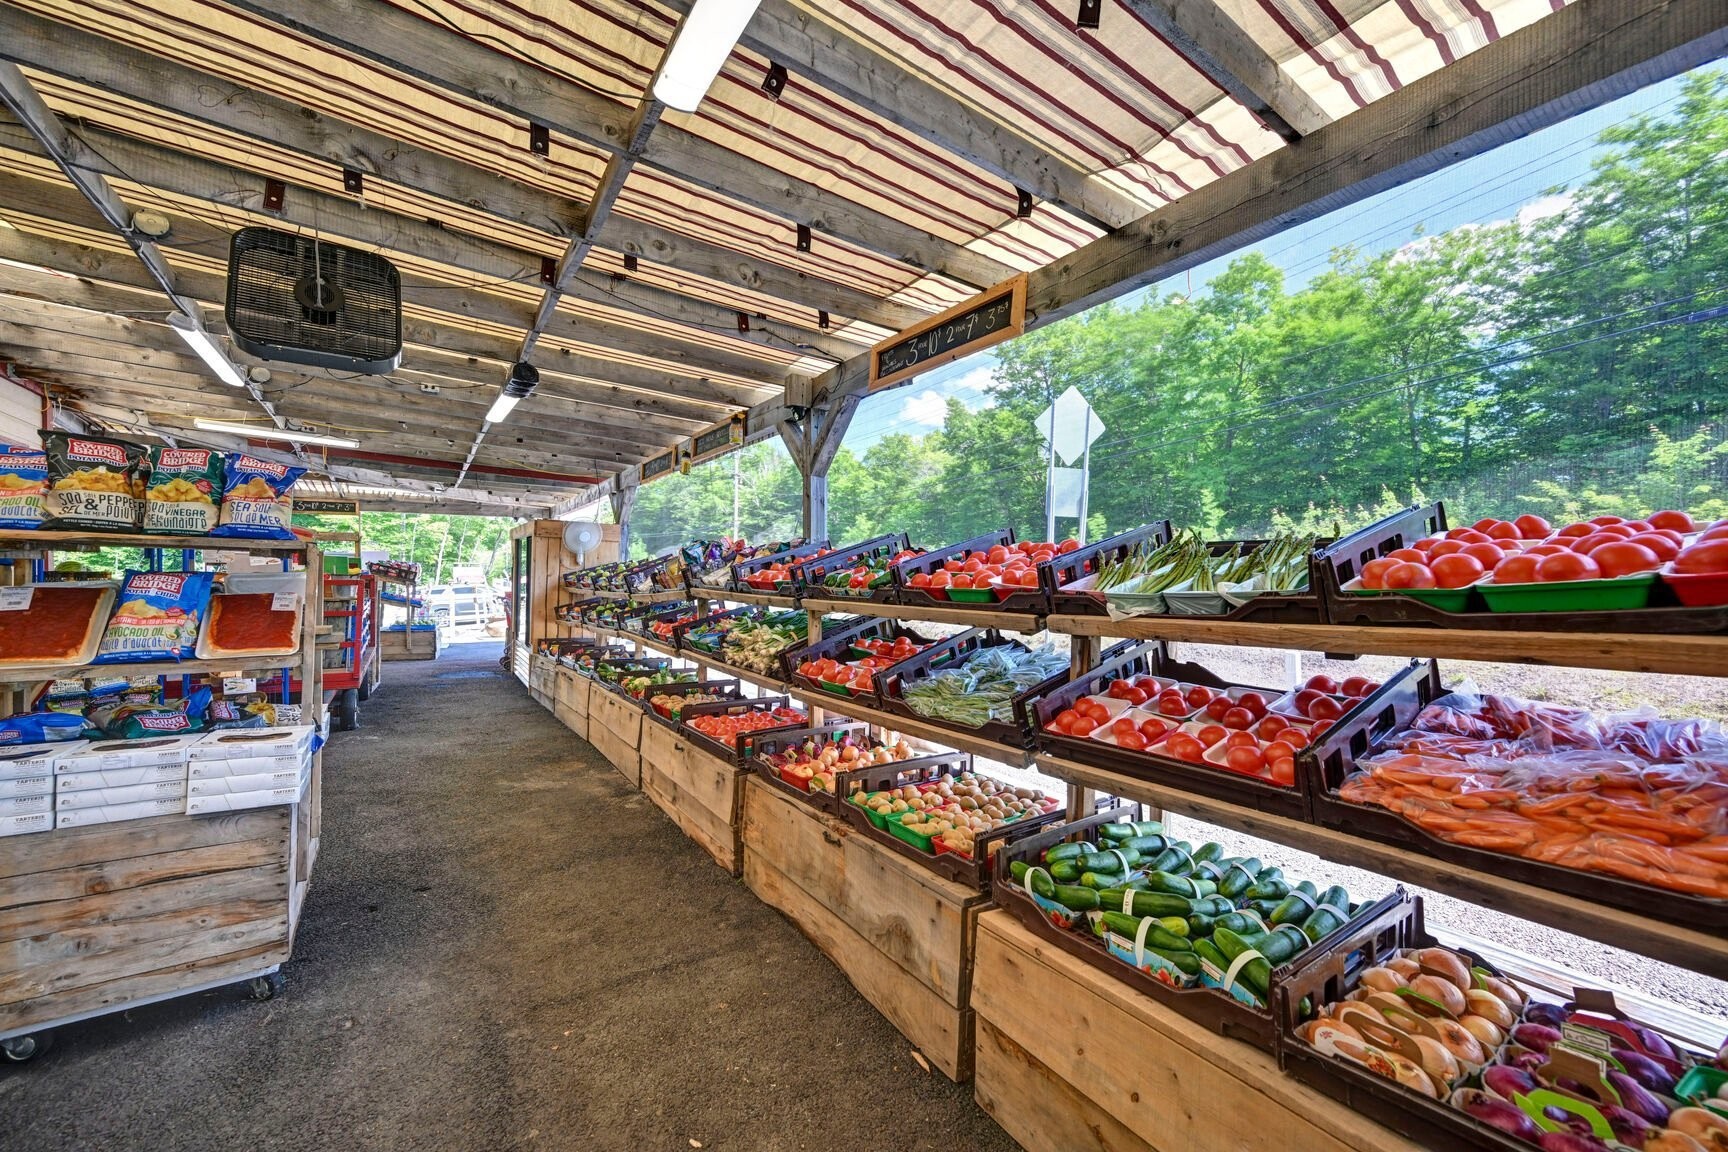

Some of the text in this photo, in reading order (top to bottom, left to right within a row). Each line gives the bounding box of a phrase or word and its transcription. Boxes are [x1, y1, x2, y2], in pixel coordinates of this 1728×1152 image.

[906, 338, 918, 366] 3
[946, 326, 954, 344] 2
[73, 442, 123, 455] COVERED
[69, 454, 103, 463] POTATO
[73, 447, 123, 462] BRIDGE
[162, 457, 205, 465] BRIDGE
[25, 496, 41, 508] OIL
[84, 498, 99, 511] &
[230, 501, 251, 512] SEA
[296, 501, 305, 511] 3
[58, 505, 82, 515] SEL
[165, 508, 206, 518] VINEGAR
[259, 514, 282, 525] MER
[134, 574, 181, 584] COVERED
[131, 580, 180, 592] BRIDGE
[155, 590, 179, 599] CHIPS
[109, 626, 165, 637] AVOCADO OIL
